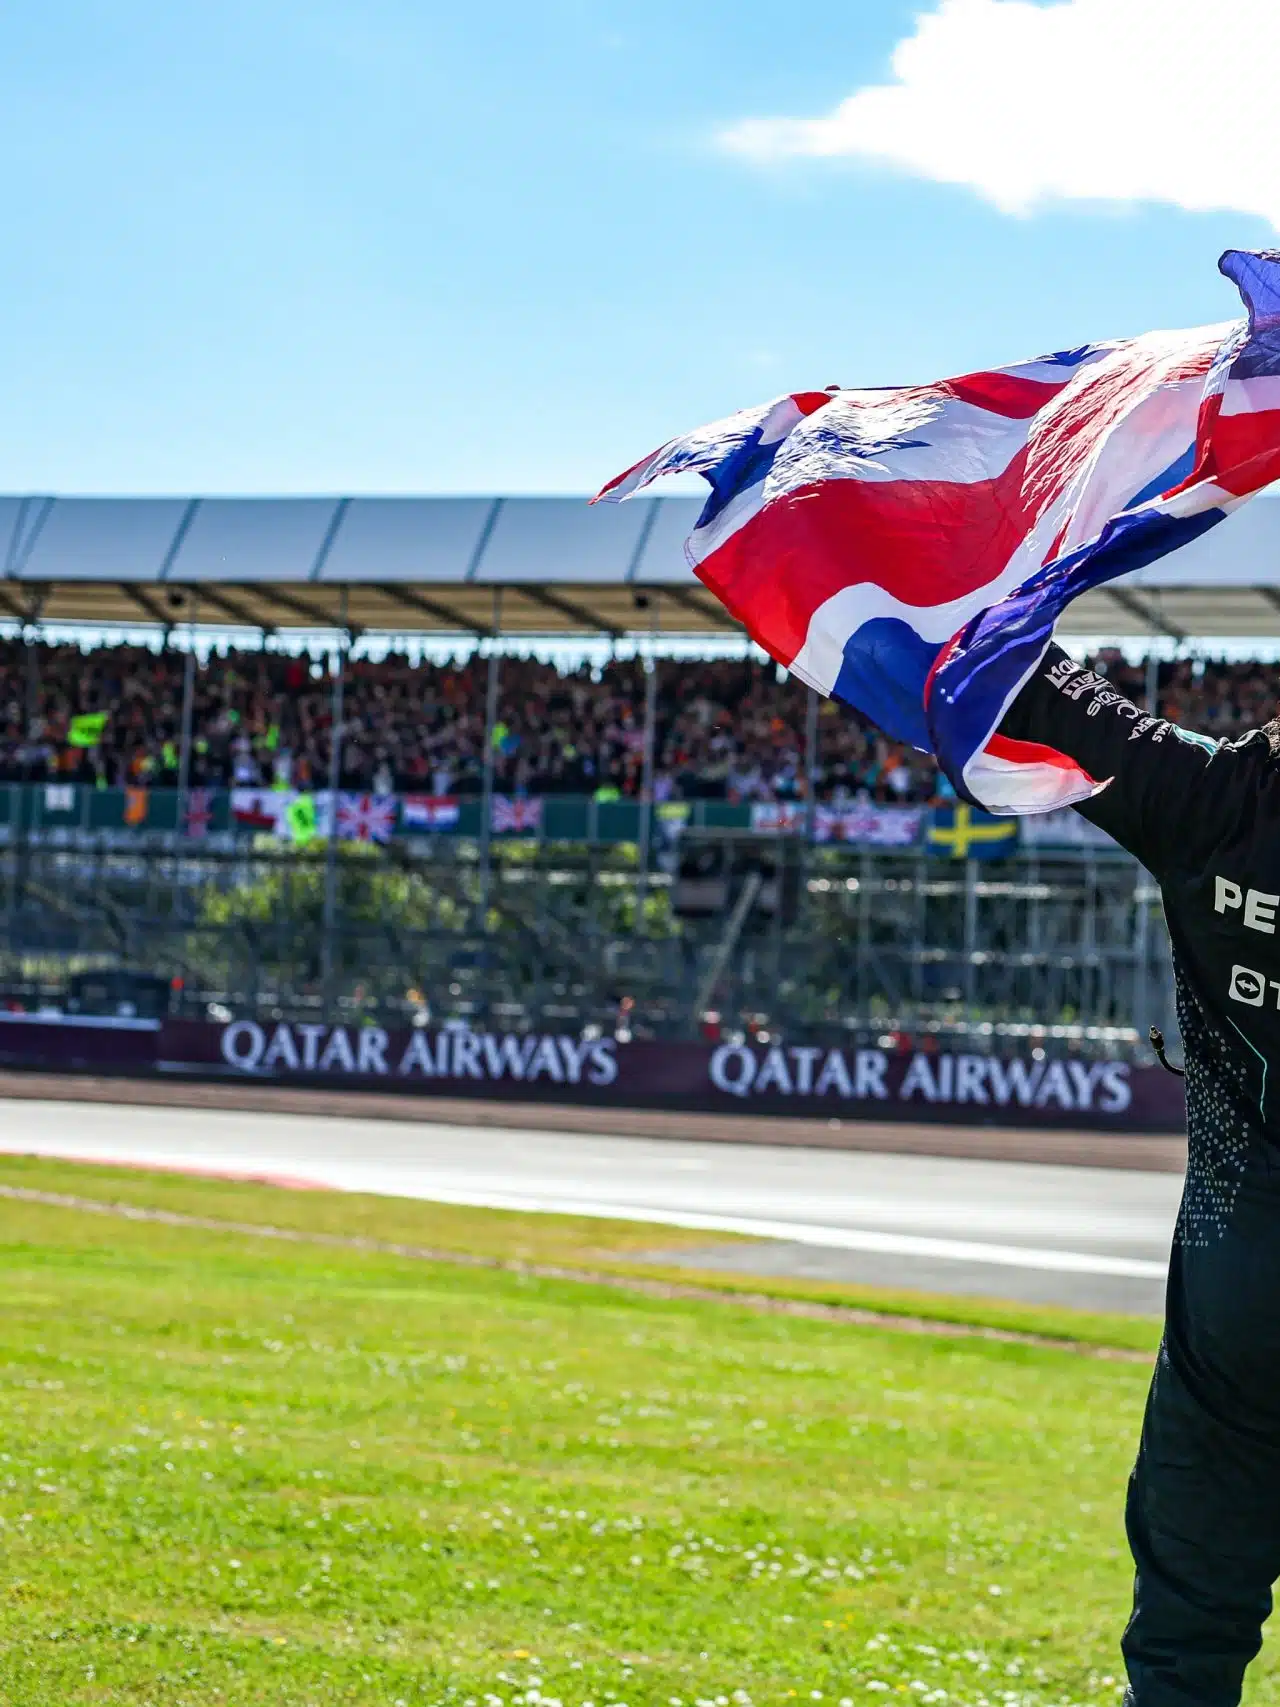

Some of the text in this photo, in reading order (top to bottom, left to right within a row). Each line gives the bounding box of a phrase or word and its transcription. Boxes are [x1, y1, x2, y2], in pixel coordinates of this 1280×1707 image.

[221, 1019, 618, 1085] QATAR AIRWAYS
[709, 1043, 1133, 1113] QATAR AIRWAYS
